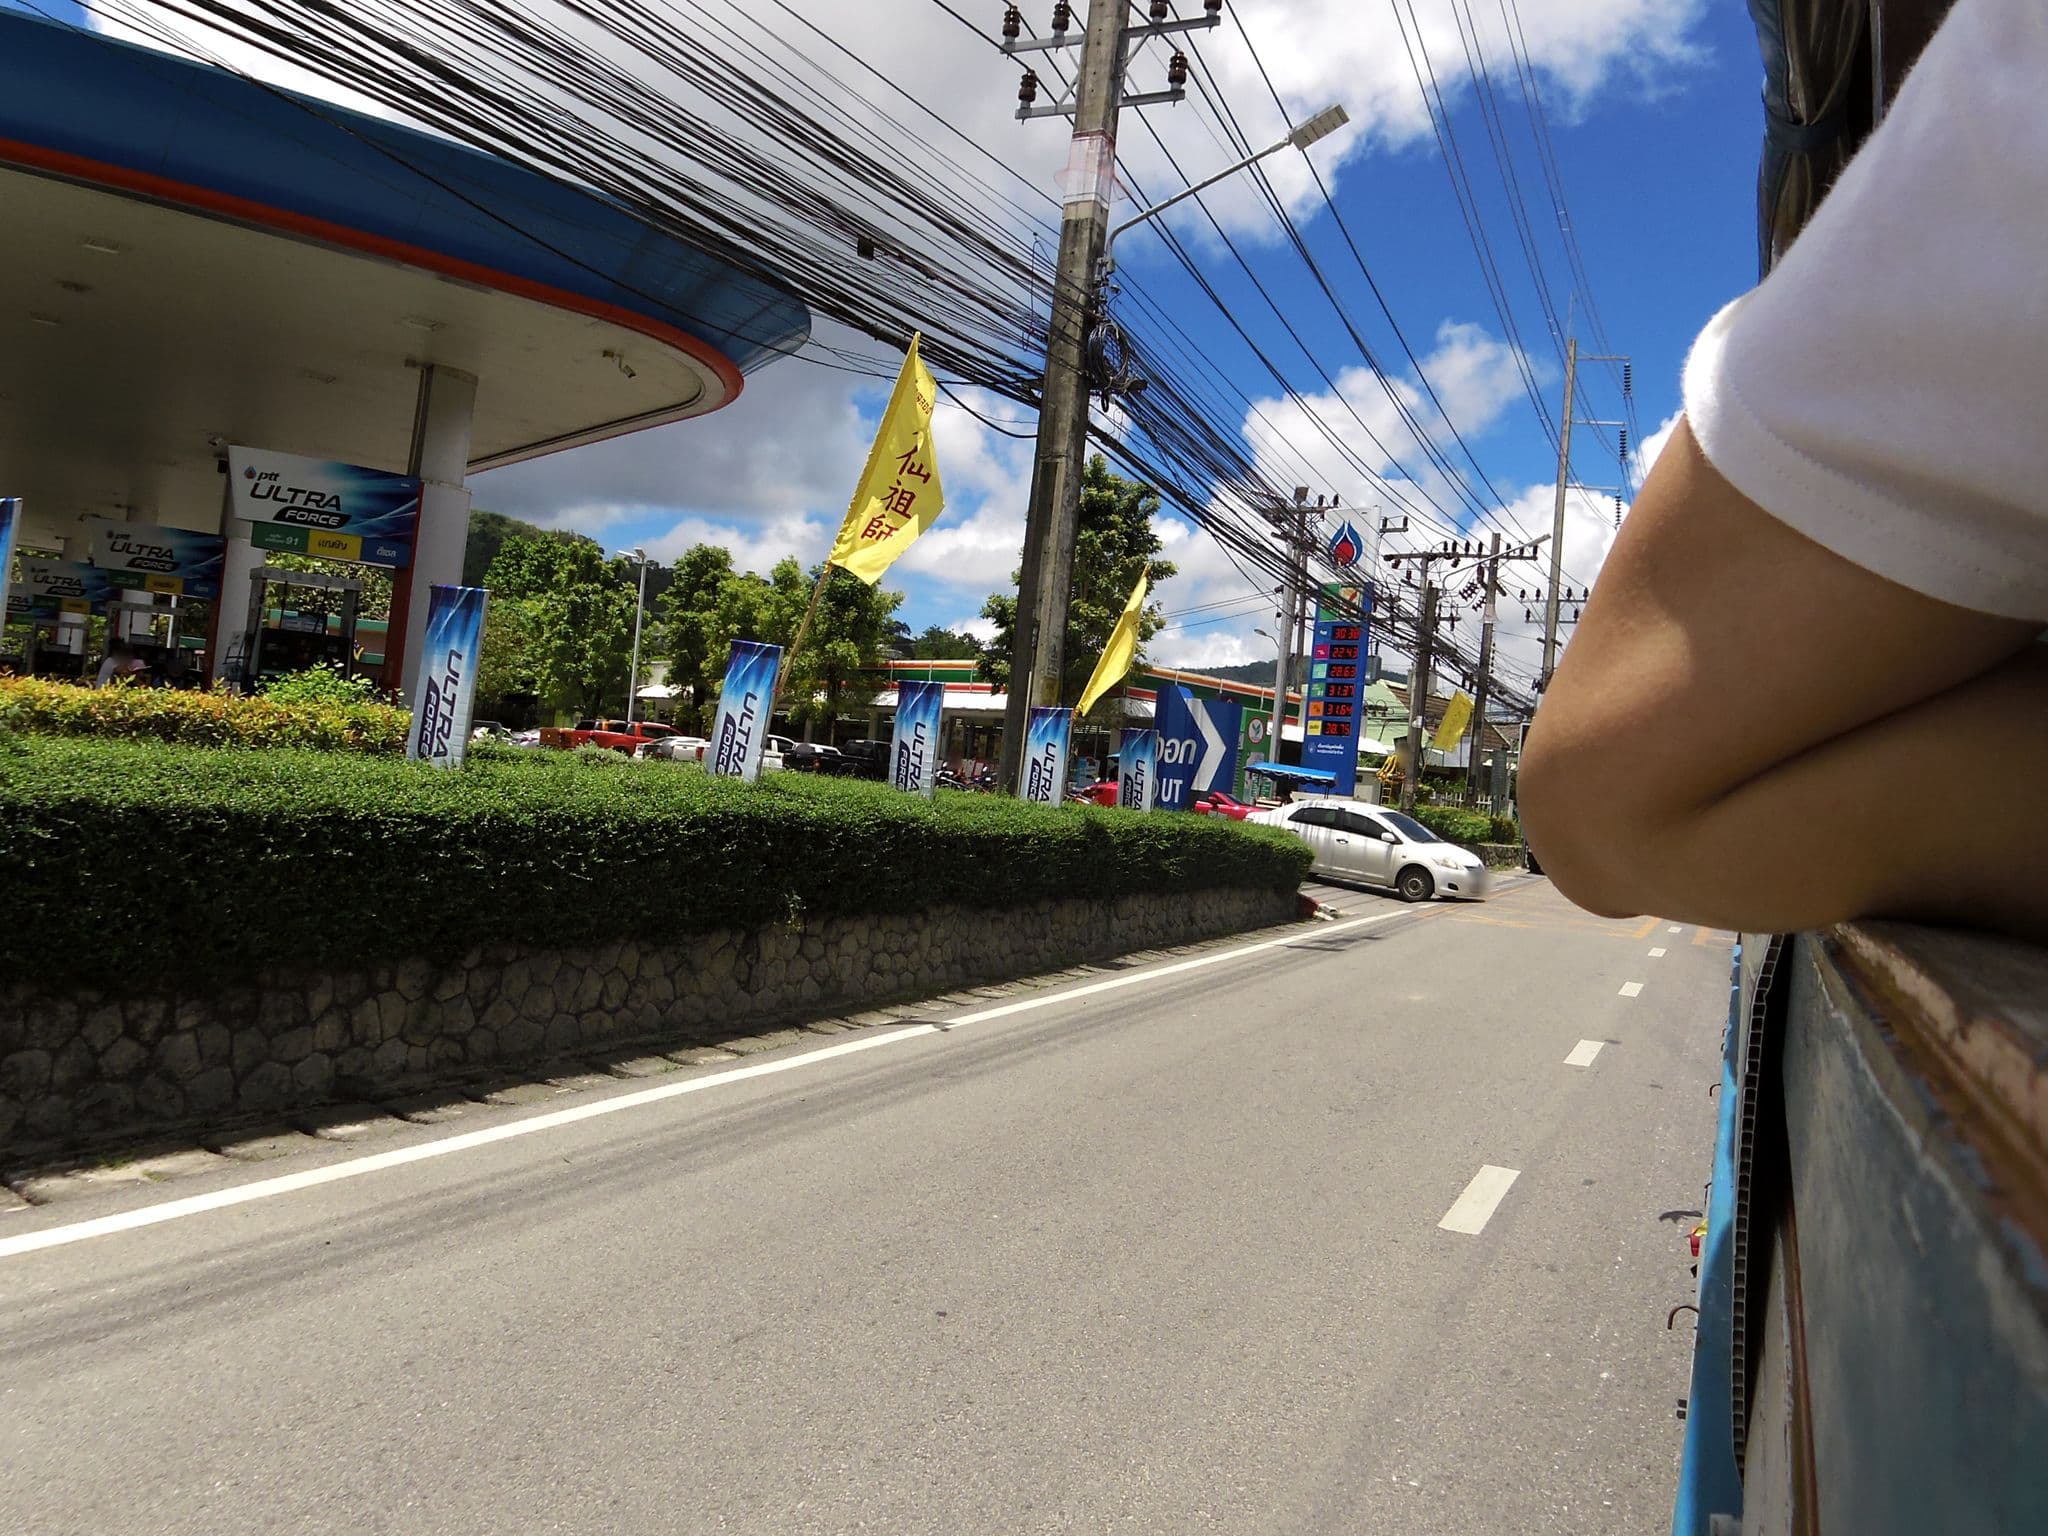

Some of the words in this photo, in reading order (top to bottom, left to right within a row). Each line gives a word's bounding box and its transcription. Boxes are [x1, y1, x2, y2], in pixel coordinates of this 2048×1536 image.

[250, 482, 342, 511] ULTRA
[257, 472, 279, 482] ptt
[861, 431, 931, 542] 仙祖師
[285, 509, 341, 526] FORCE
[110, 541, 174, 560] ULTRA
[8, 595, 29, 604] TRA
[33, 575, 82, 586] ULTRA
[420, 691, 437, 756] FORCE
[433, 649, 462, 757] ULTRA
[730, 691, 758, 776] ULTRA
[909, 721, 926, 791] ULTRA
[1040, 742, 1056, 802] ULTRA
[1133, 759, 1146, 810] ULTRA
